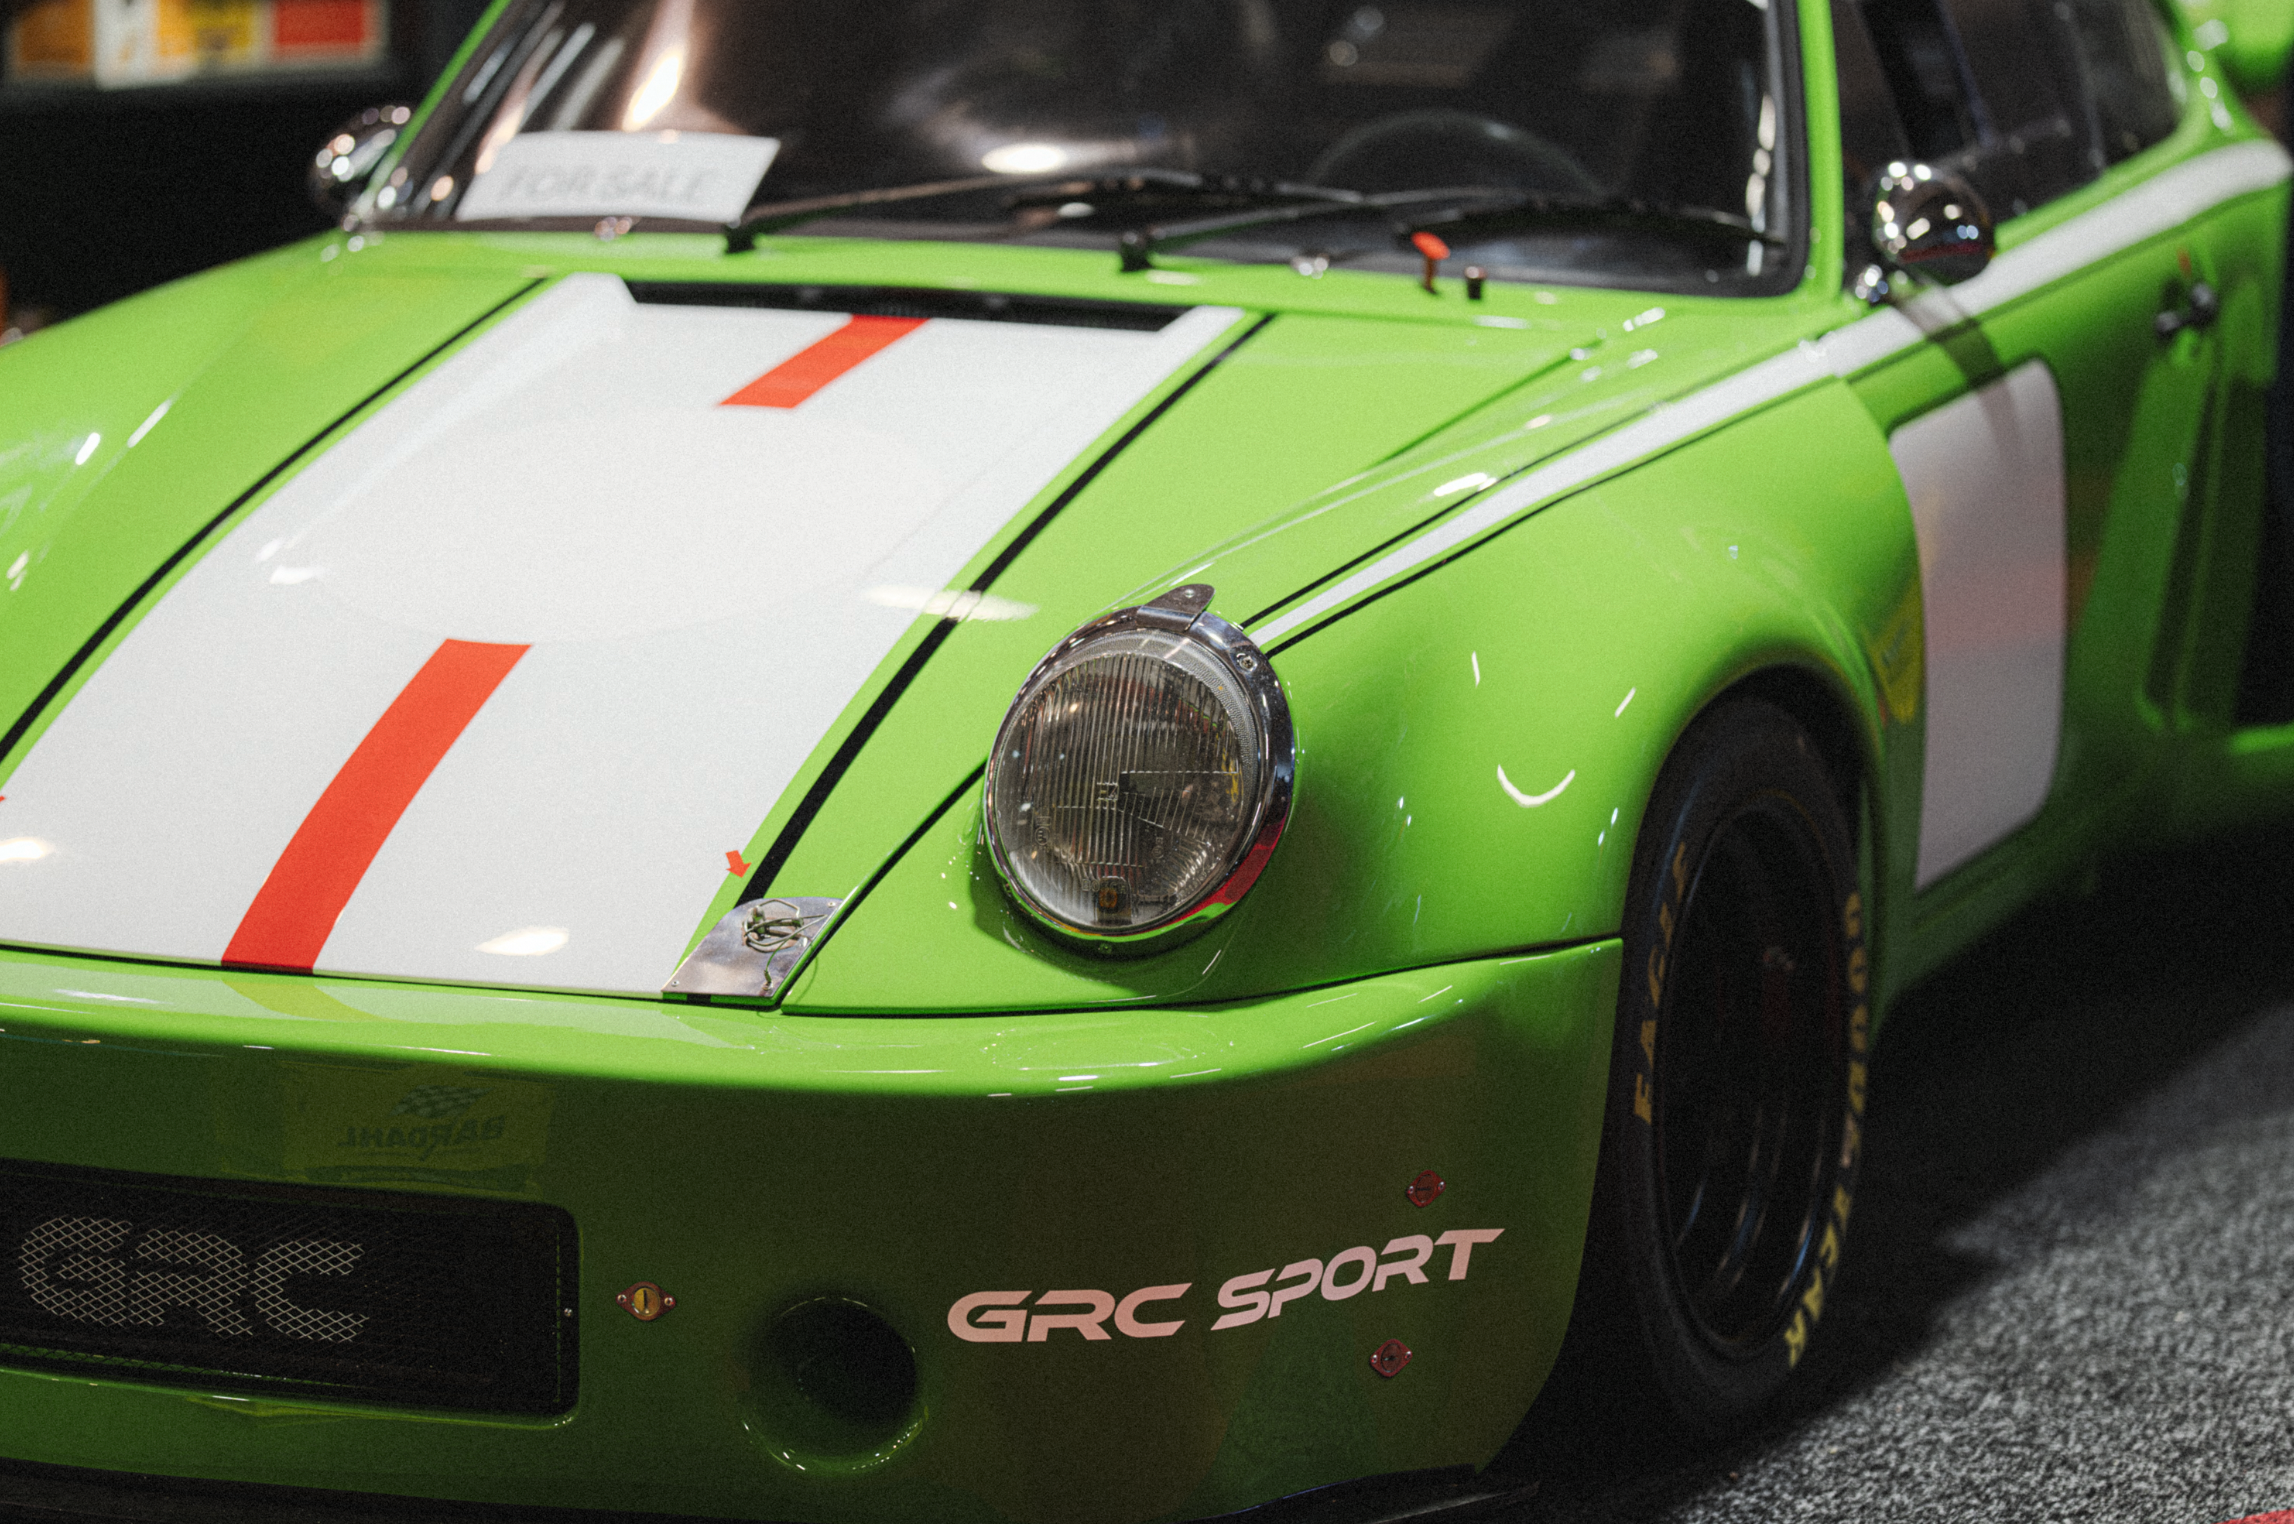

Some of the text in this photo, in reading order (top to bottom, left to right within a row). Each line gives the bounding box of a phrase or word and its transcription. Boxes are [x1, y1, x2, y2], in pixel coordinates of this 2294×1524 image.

[499, 163, 721, 204] FOR SALE
[18, 1213, 370, 1343] GRC
[947, 1228, 1505, 1342] GRC SPORT
